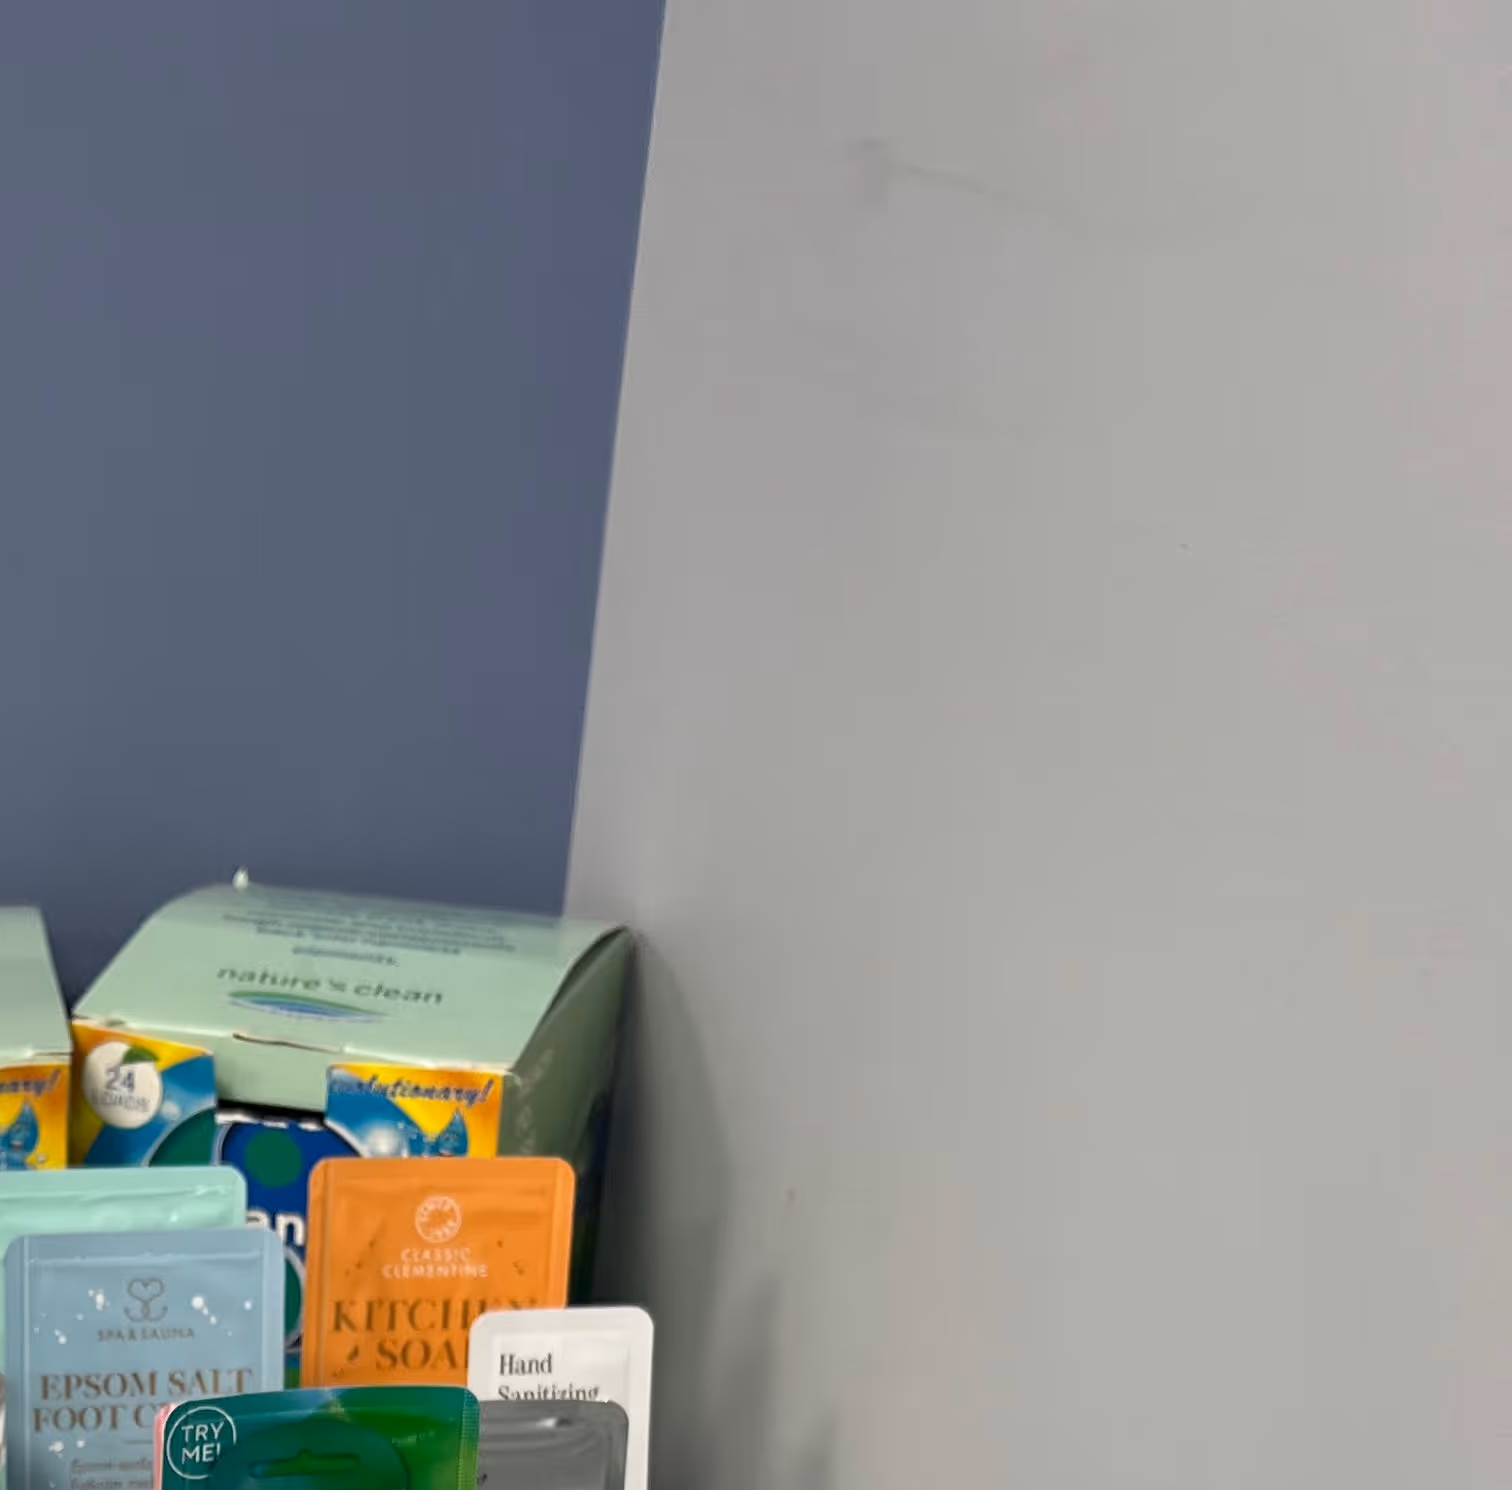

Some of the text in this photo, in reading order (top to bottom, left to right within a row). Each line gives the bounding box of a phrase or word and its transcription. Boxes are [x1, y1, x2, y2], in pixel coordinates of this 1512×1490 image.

[353, 983, 444, 1005] clean
[104, 1071, 137, 1094] 24
[332, 1296, 538, 1331] KITCH
[376, 1338, 469, 1370] SOA
[499, 1353, 553, 1376] Hand
[40, 1368, 254, 1401] EPSOM SALT
[32, 1405, 129, 1433] FOOT
[181, 1421, 225, 1443] TRY
[182, 1443, 220, 1465] ME!
